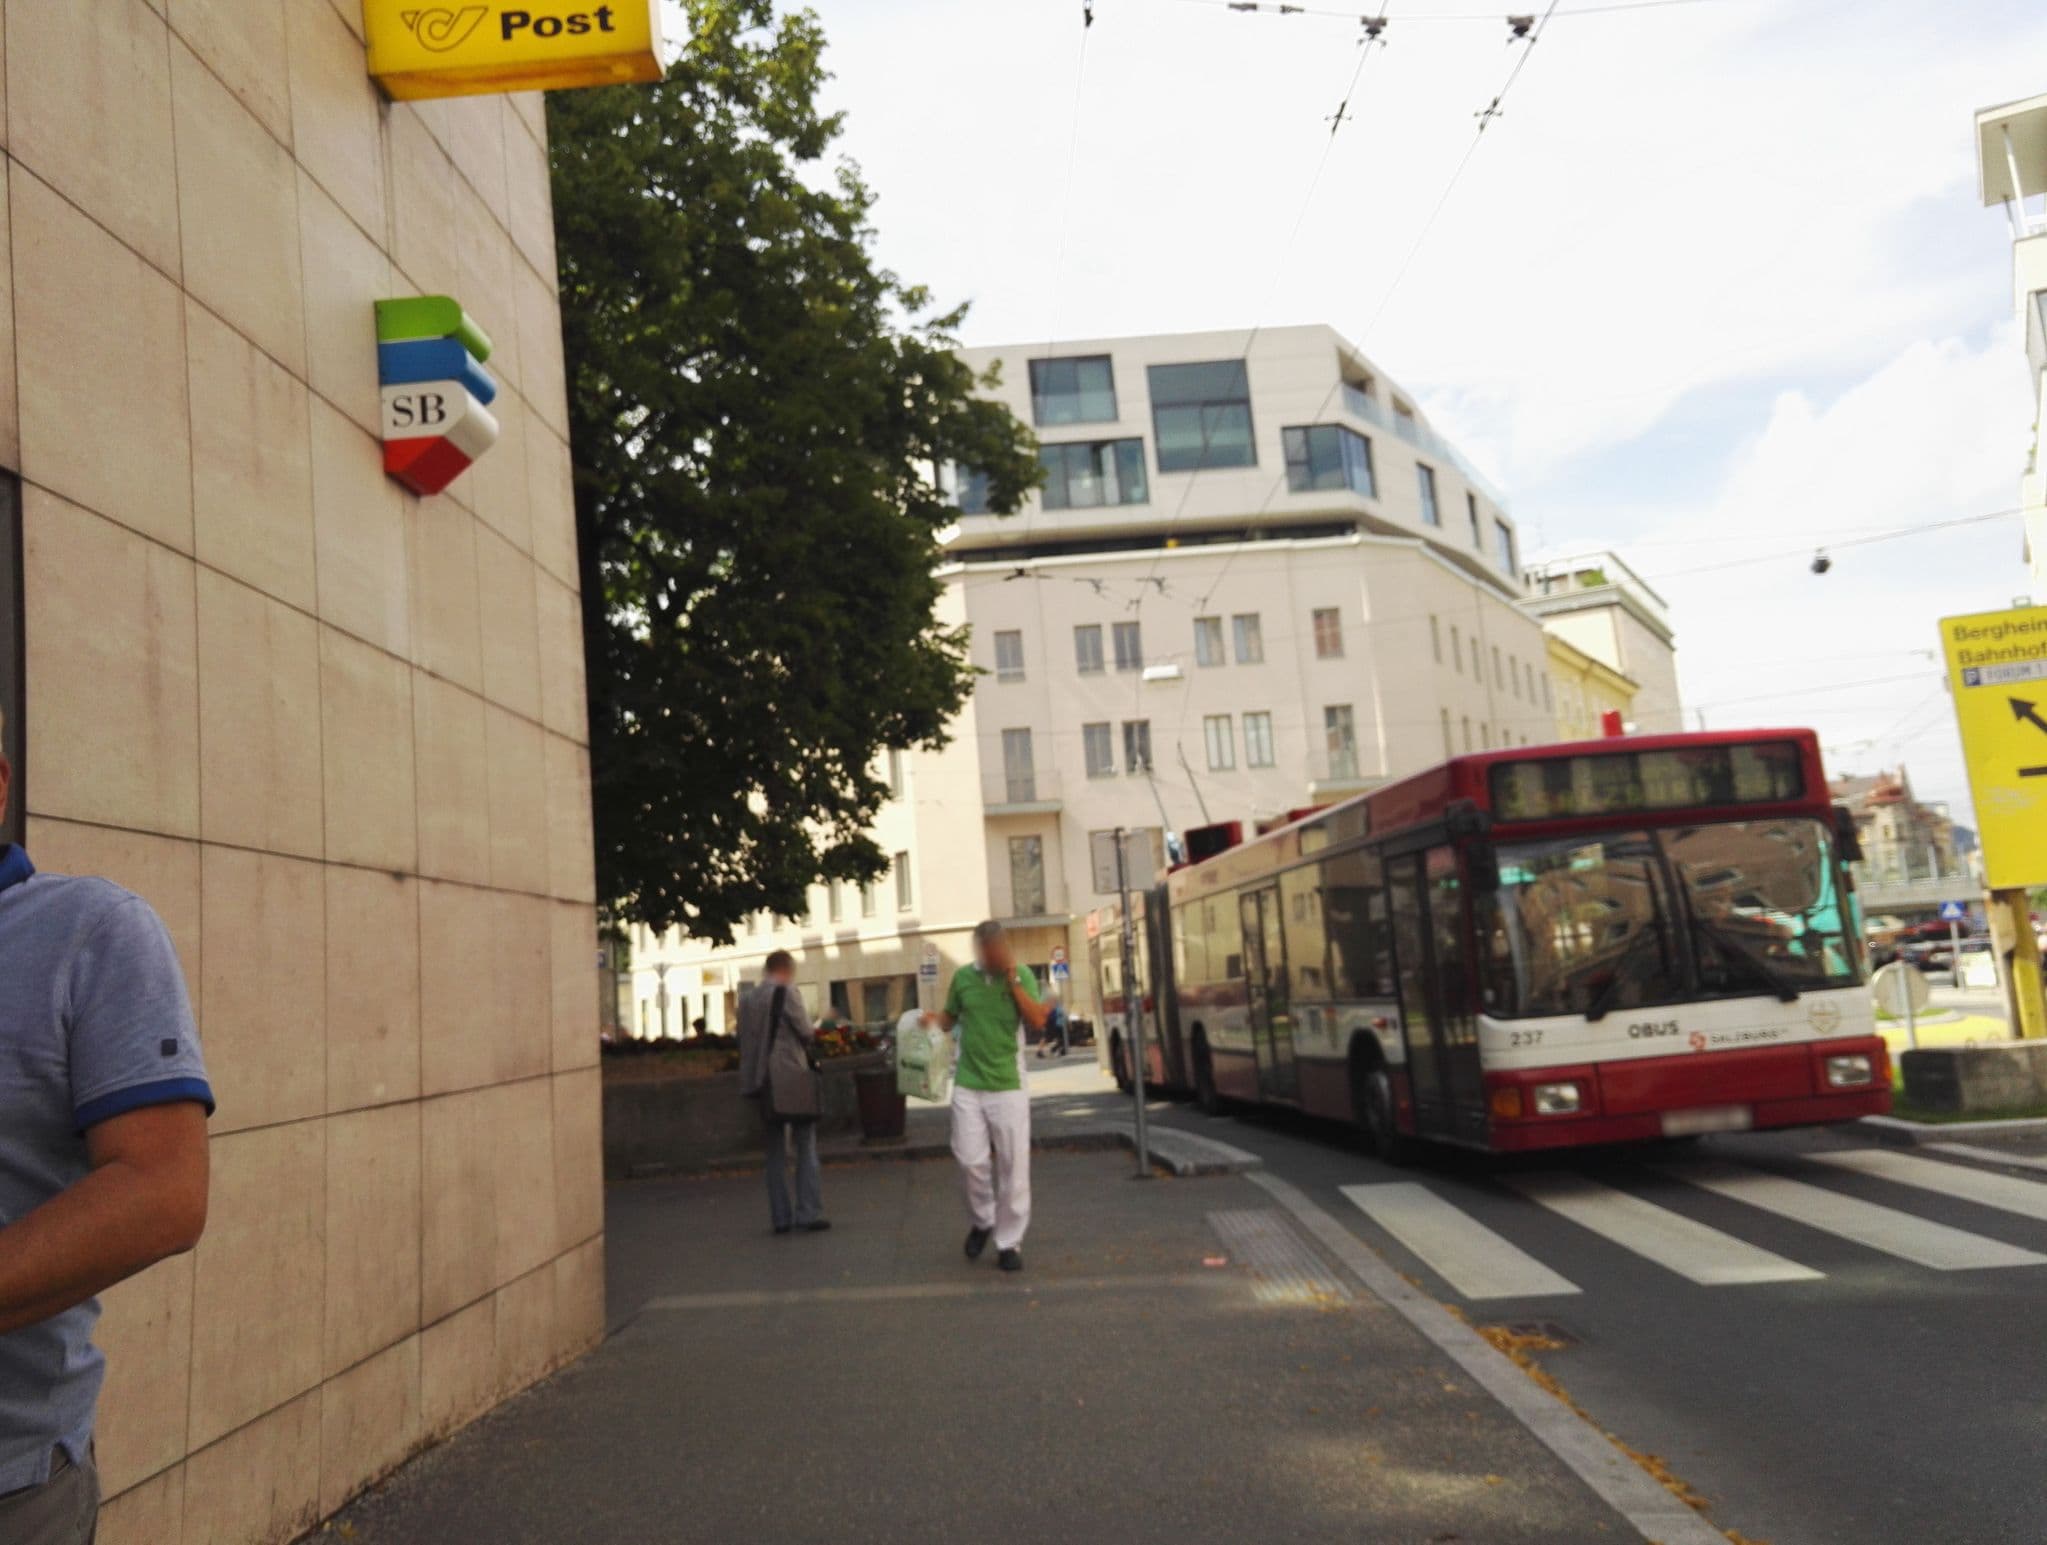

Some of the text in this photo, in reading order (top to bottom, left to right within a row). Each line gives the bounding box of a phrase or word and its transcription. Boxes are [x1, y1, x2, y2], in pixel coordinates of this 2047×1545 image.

[501, 5, 615, 41] Post
[393, 393, 446, 427] SB
[1958, 641, 2047, 665] Bahnhof
[1510, 1030, 1543, 1047] 237
[1628, 1020, 1680, 1038] OBUS
